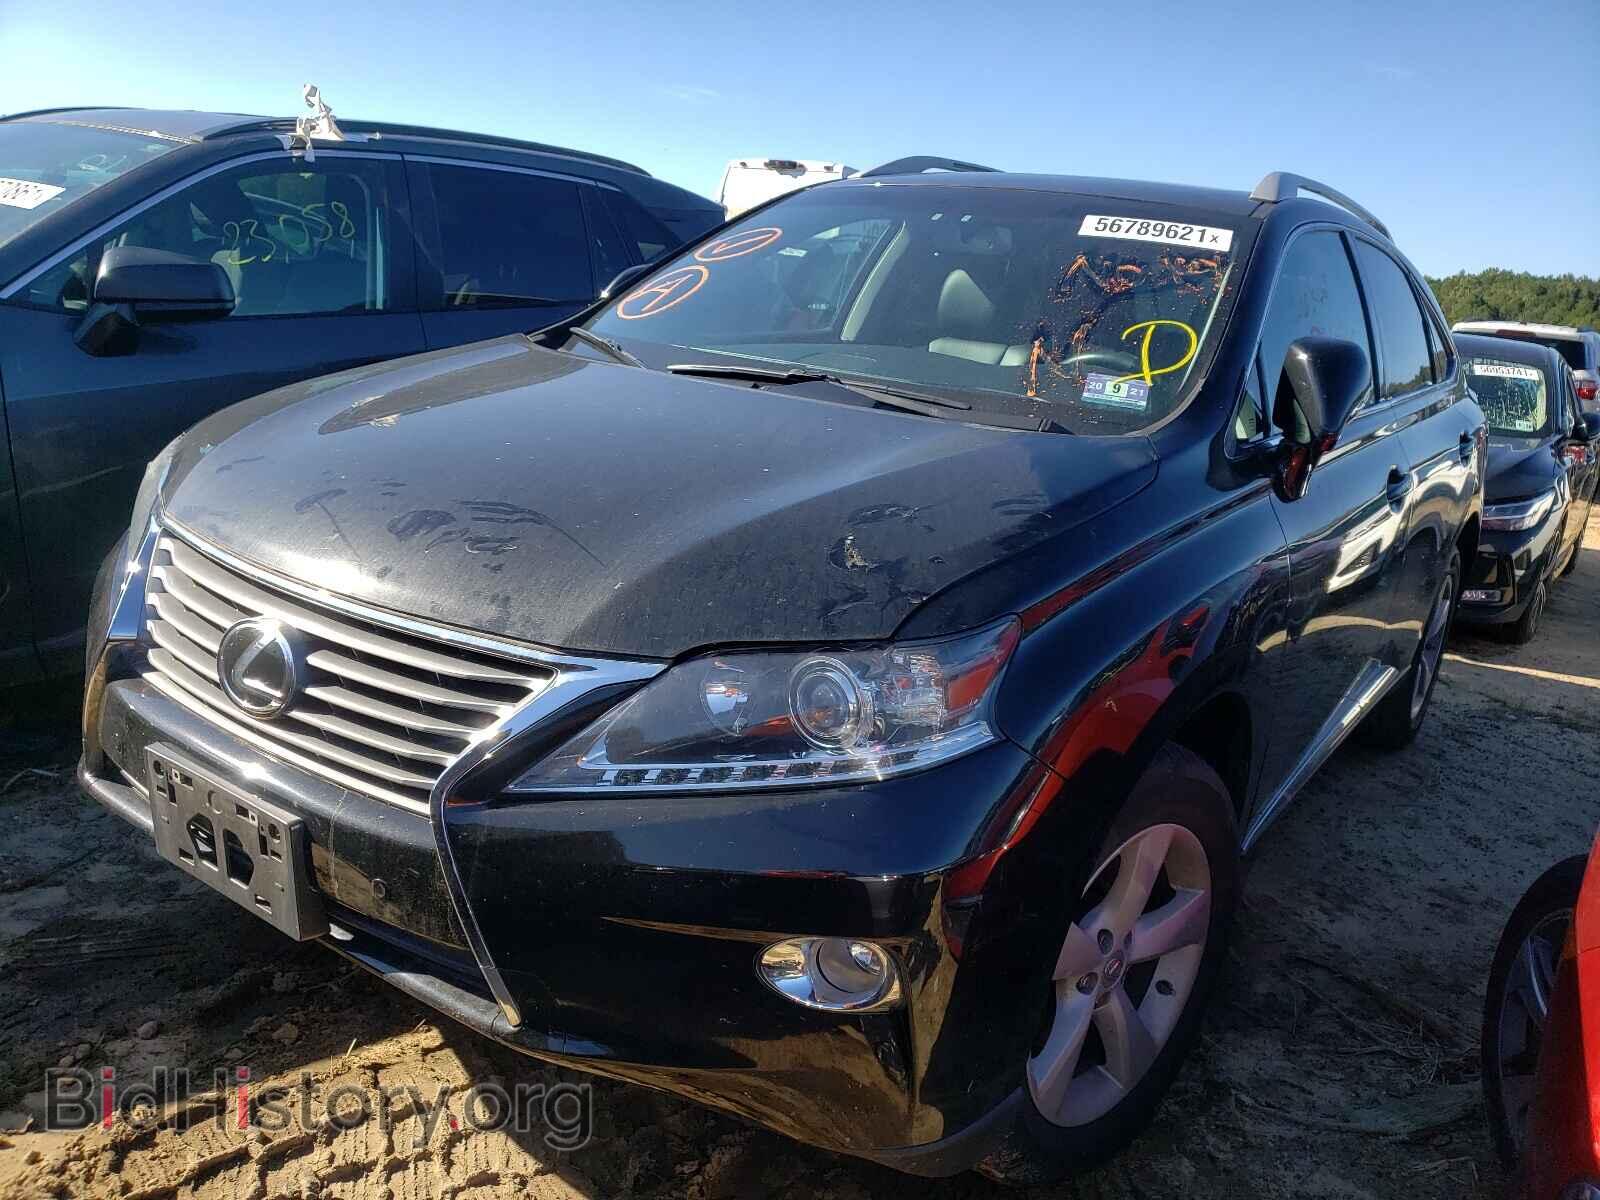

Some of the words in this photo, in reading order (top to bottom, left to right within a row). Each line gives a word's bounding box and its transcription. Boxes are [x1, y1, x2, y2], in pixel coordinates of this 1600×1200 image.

[1087, 381, 1103, 391] 20
[1112, 383, 1122, 394] 9
[1129, 387, 1144, 397] 21
